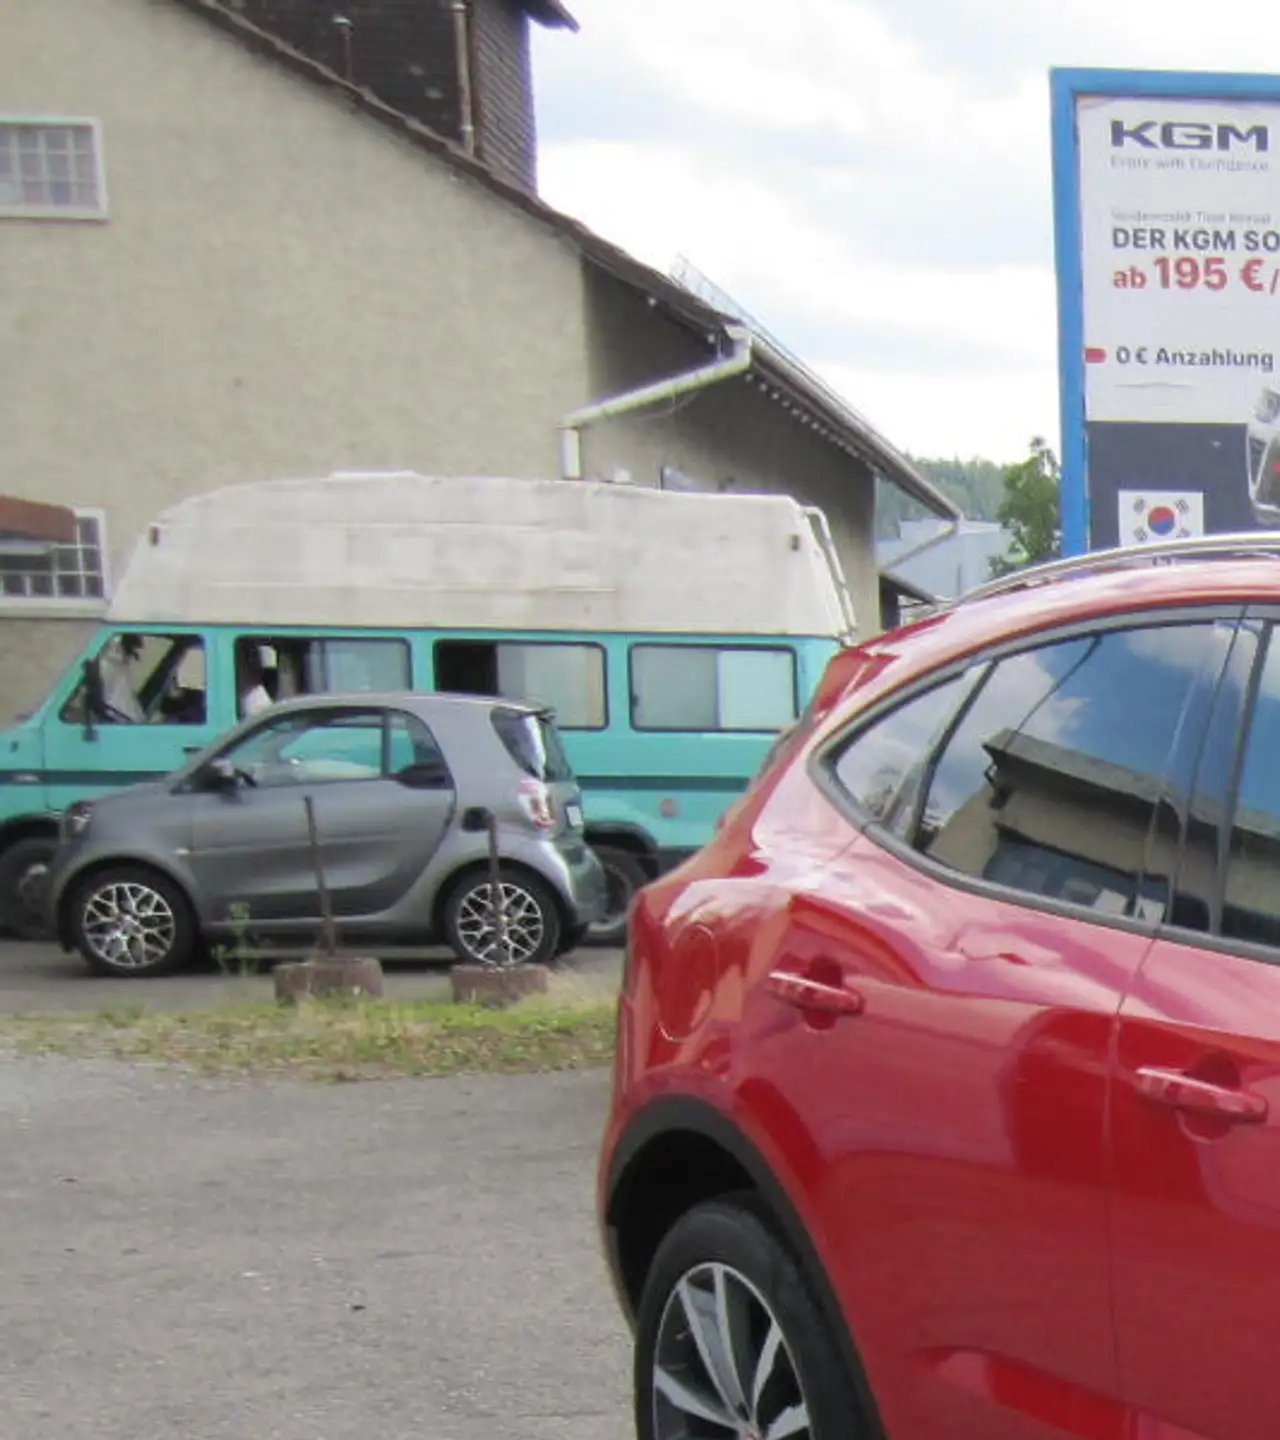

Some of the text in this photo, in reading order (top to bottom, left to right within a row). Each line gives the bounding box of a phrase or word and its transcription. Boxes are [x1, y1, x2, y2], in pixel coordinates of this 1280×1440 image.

[1111, 120, 1268, 152] KGM
[1111, 227, 1167, 250] DER
[1173, 229, 1236, 251] KGM
[1113, 265, 1147, 290] ab
[1153, 256, 1228, 291] 195
[1239, 258, 1265, 293] €
[1155, 347, 1275, 373] Anzahlung
